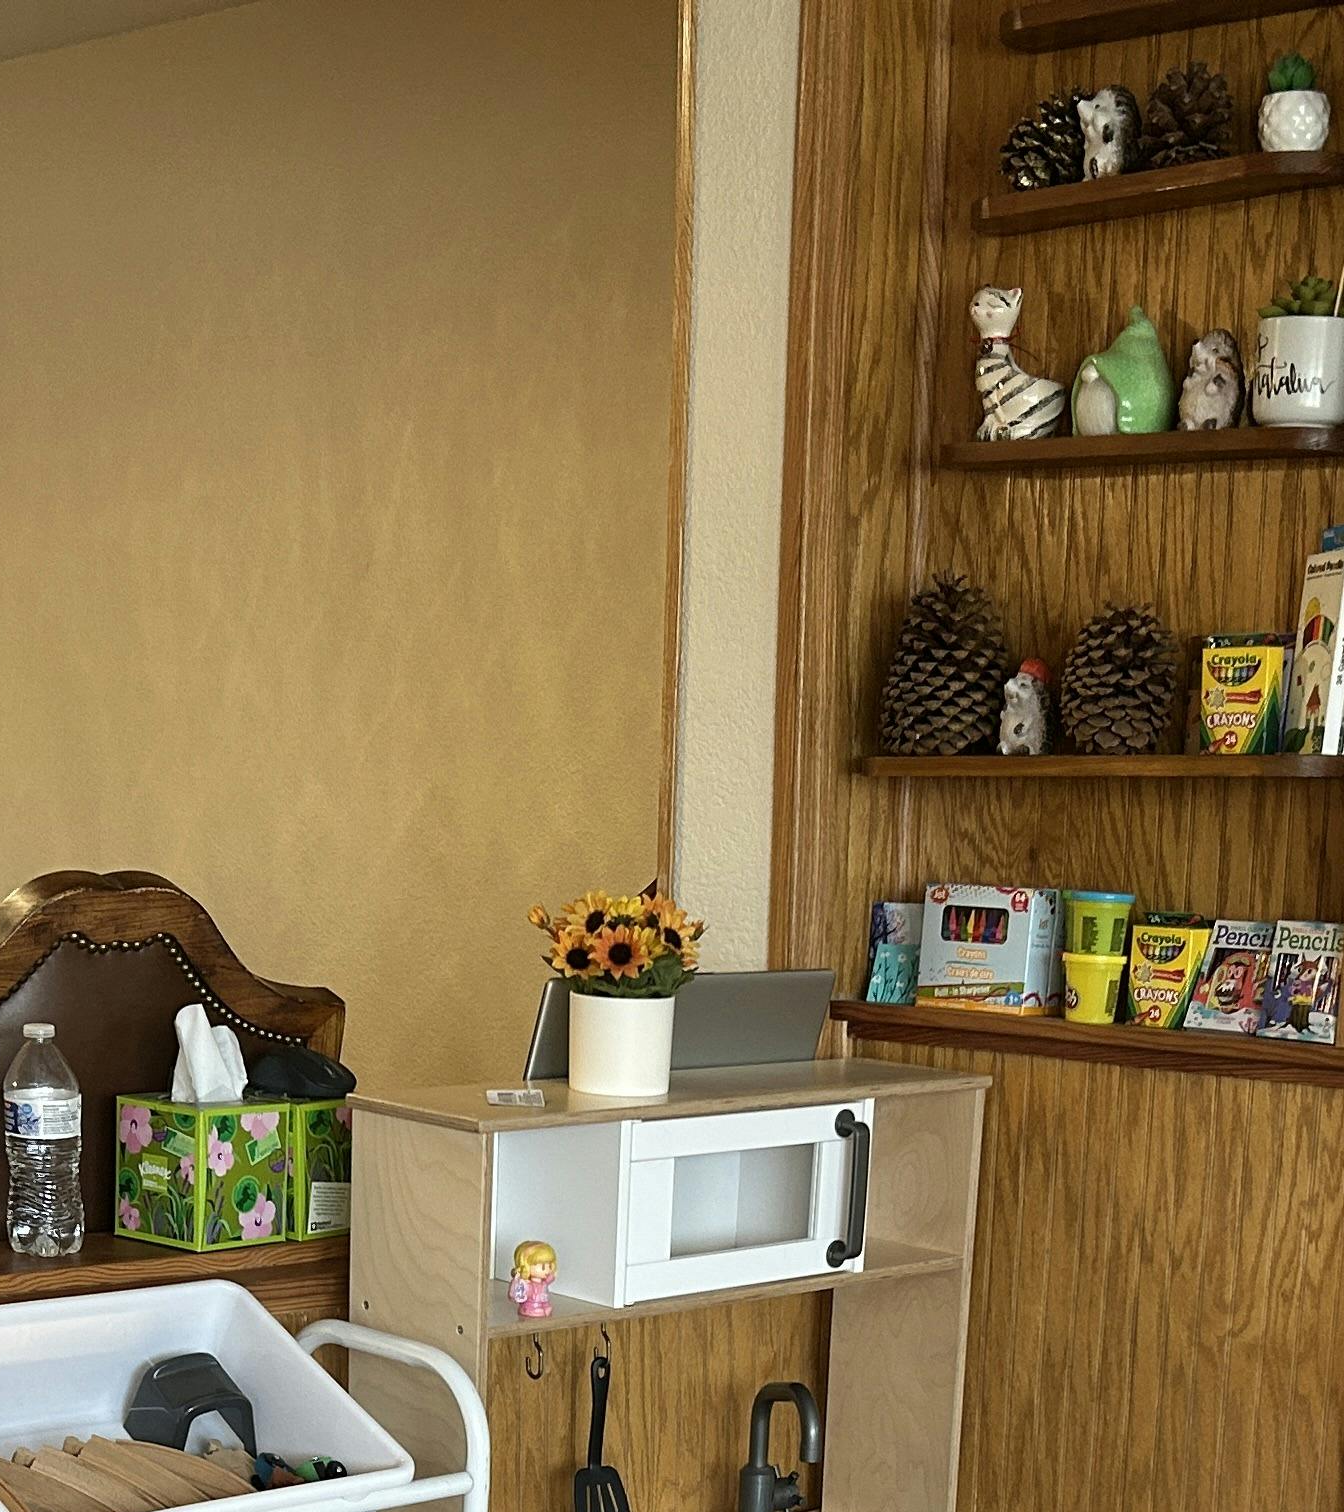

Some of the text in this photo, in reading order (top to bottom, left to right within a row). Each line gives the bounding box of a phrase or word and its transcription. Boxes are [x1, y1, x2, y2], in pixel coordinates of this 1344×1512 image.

[1211, 653, 1256, 667] Crayola
[1206, 712, 1256, 728] CRAYONS
[1226, 735, 1237, 746] 24
[1141, 932, 1182, 947] Crayola
[1276, 926, 1344, 952] Pencils
[1134, 988, 1179, 1005] CRAYONS
[1149, 1009, 1160, 1019] 24
